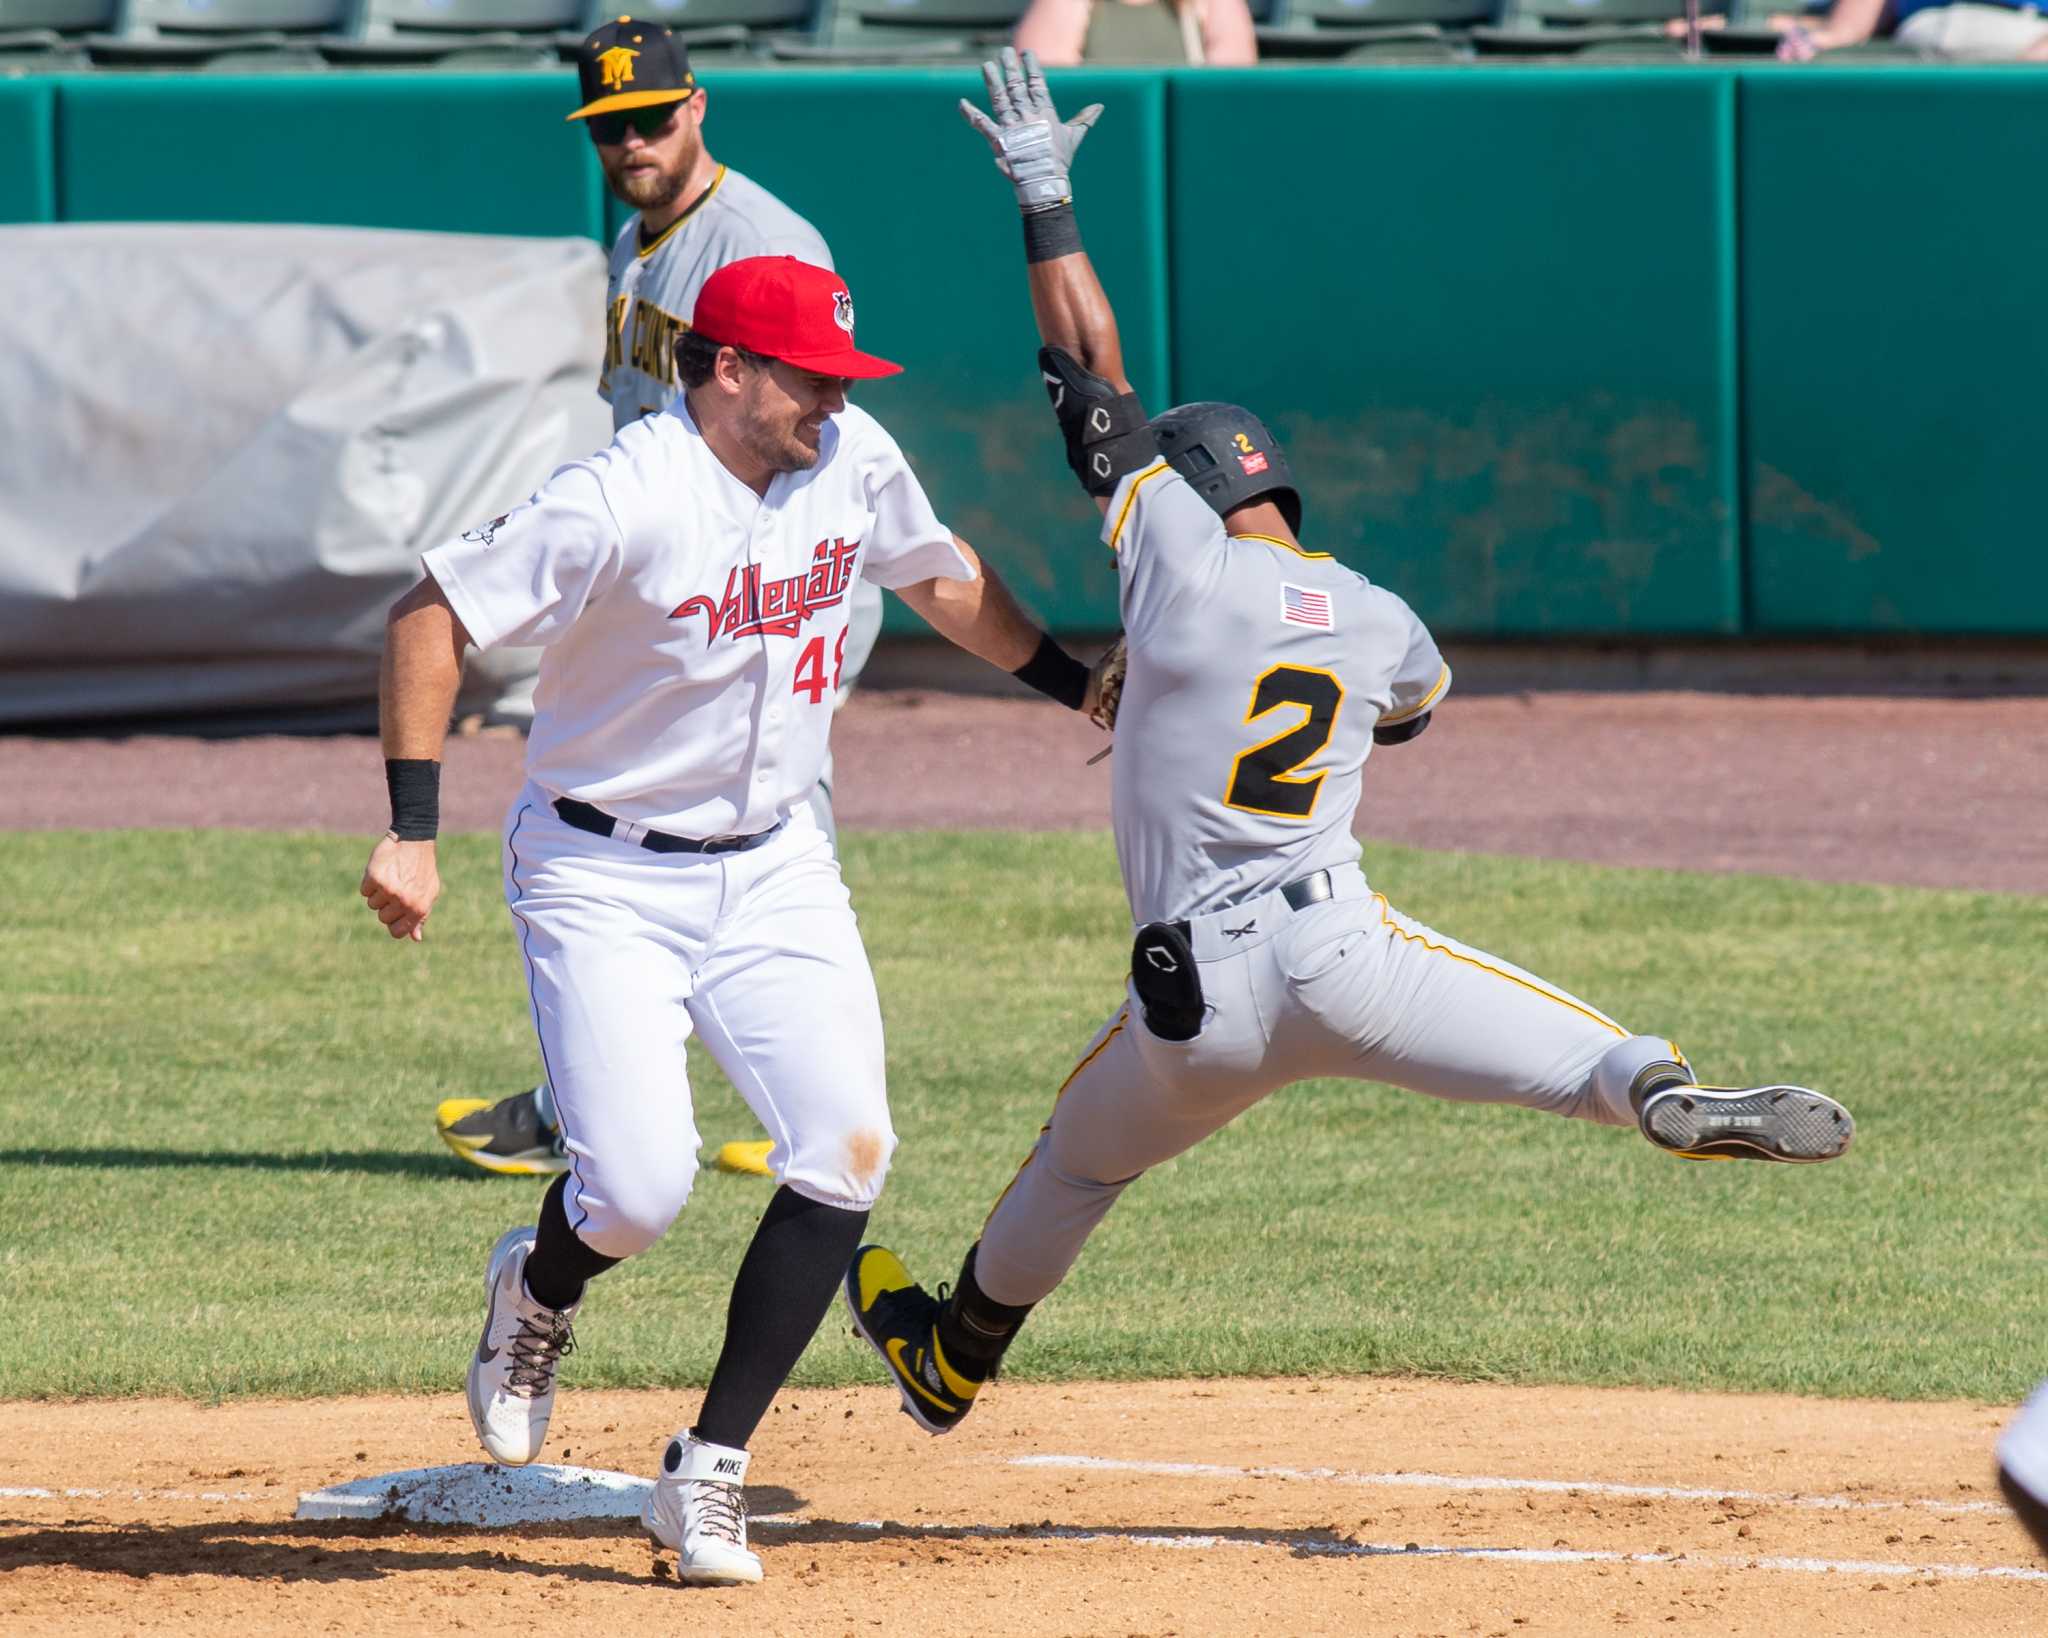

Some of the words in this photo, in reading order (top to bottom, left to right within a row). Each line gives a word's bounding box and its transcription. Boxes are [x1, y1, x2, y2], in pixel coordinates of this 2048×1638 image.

[1234, 433, 1254, 453] 2
[1224, 662, 1345, 820] 2
[712, 1457, 742, 1475] NIKE
